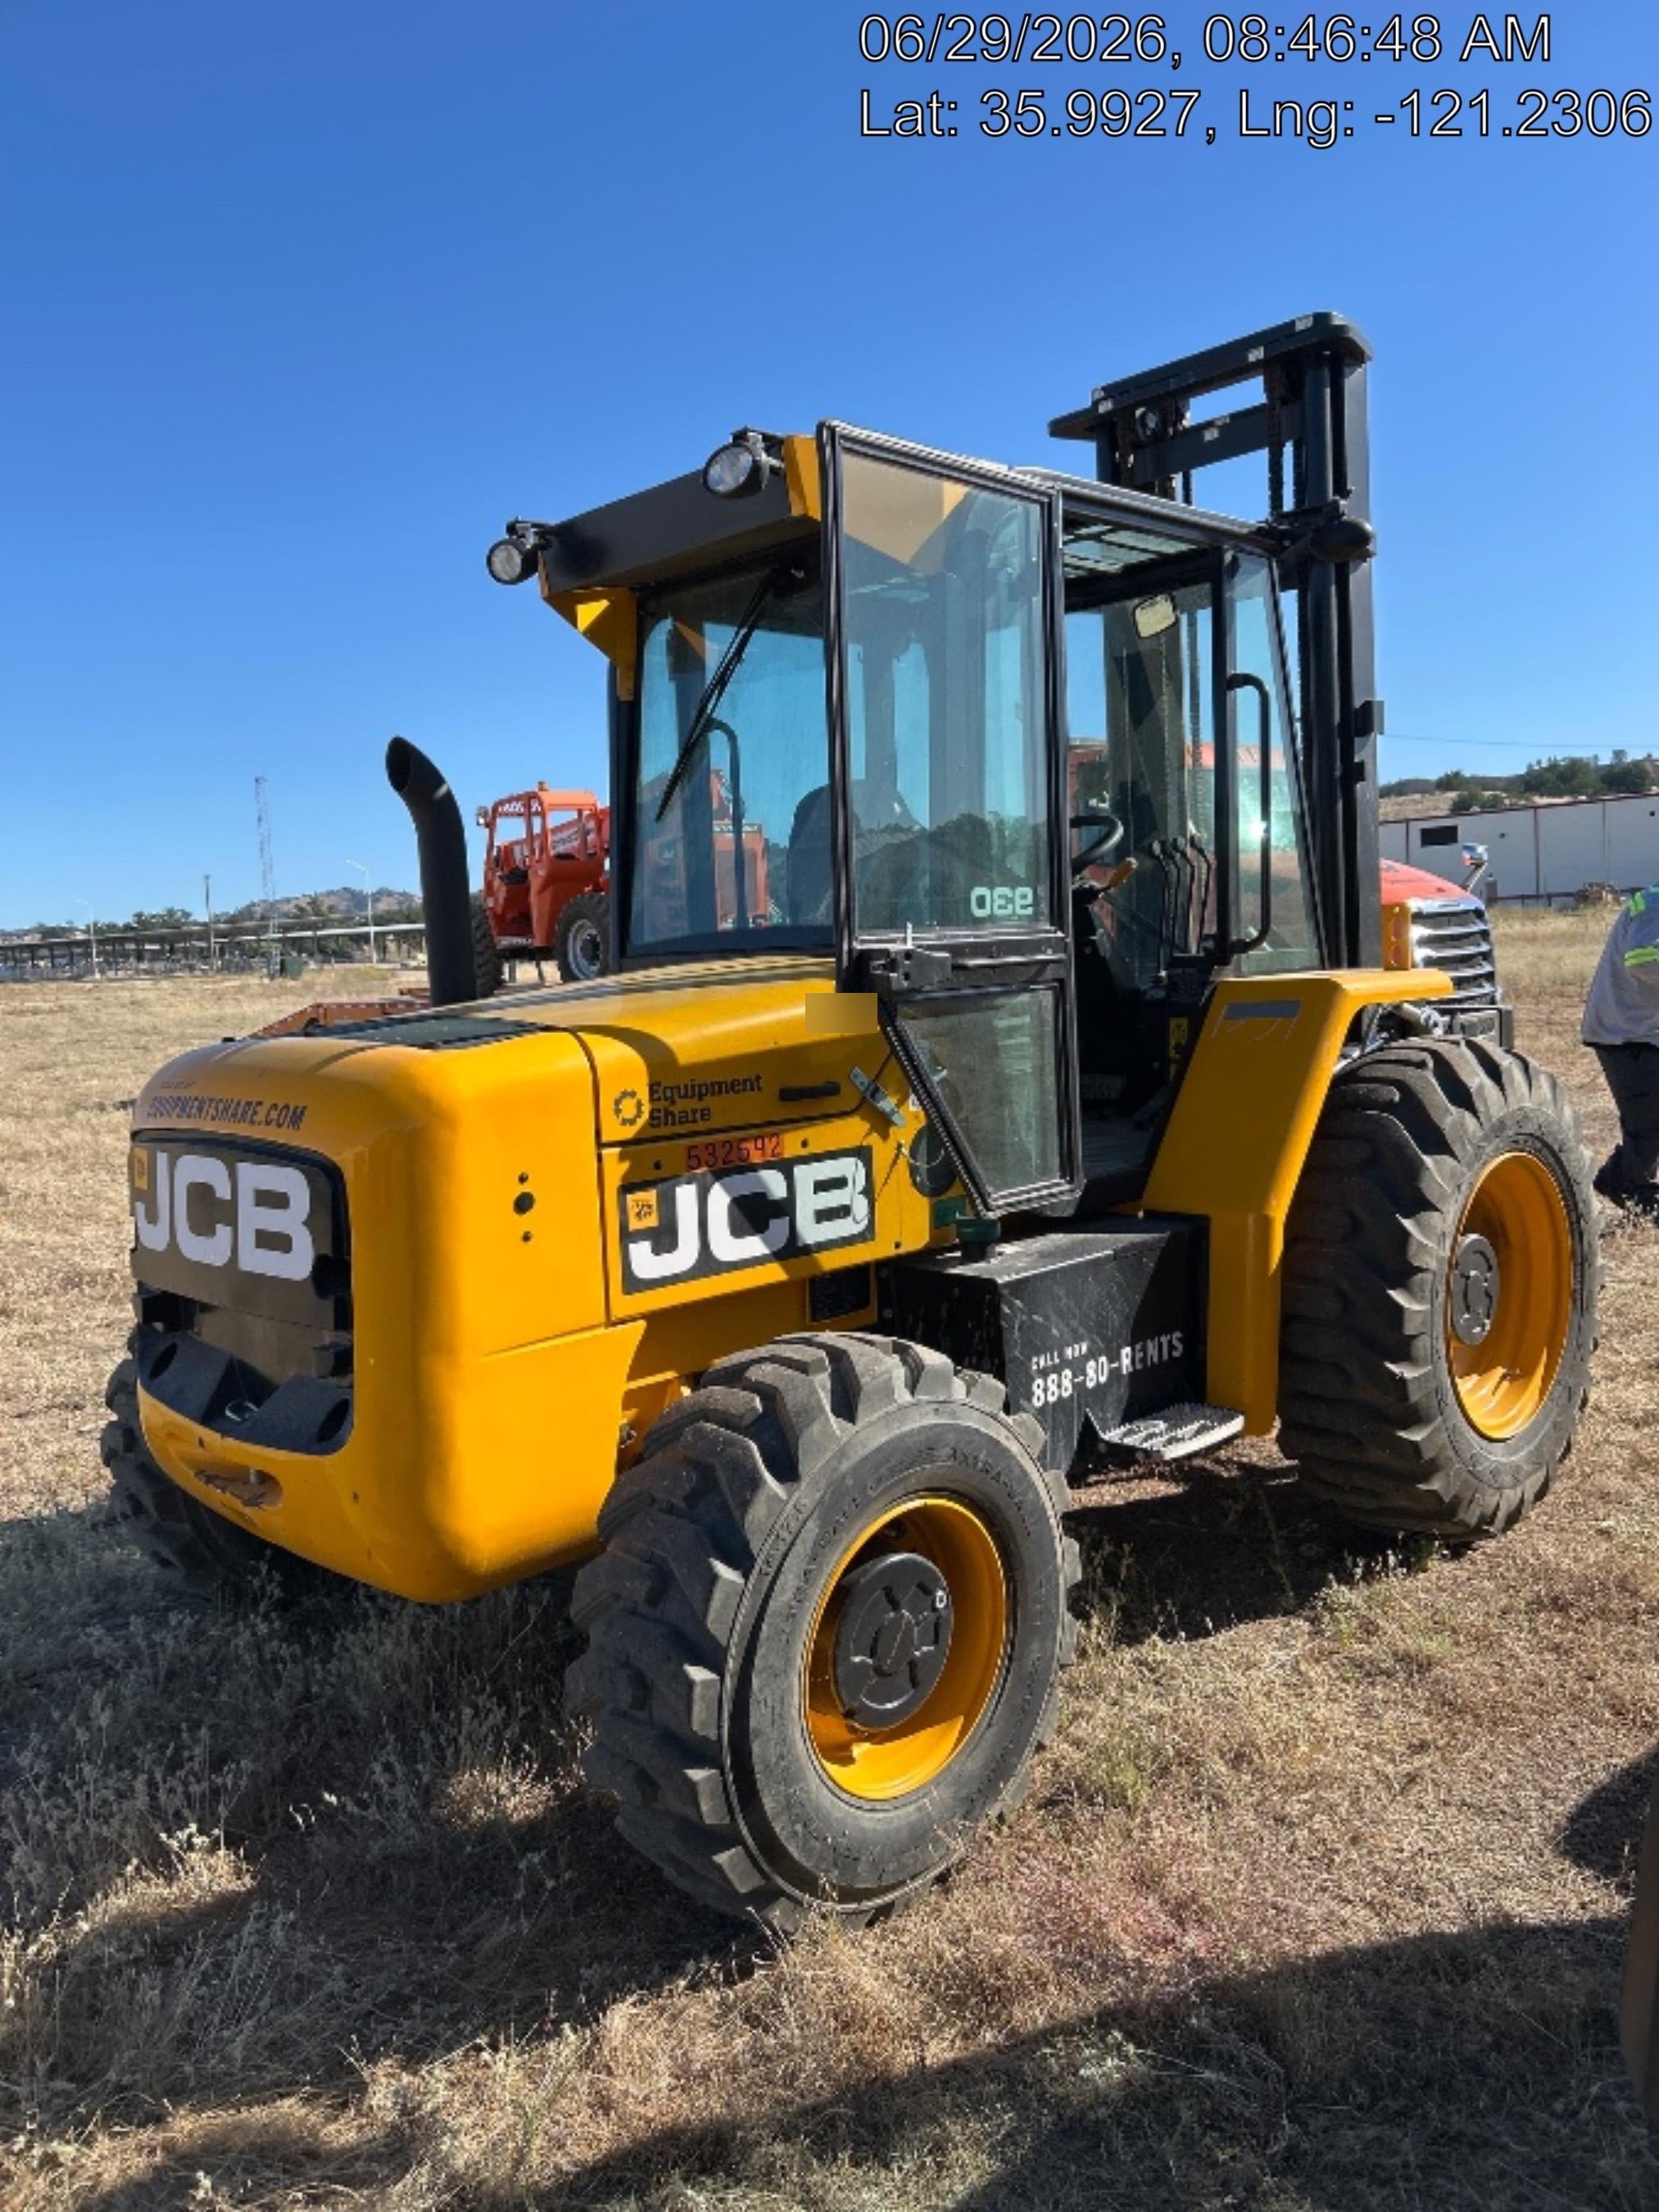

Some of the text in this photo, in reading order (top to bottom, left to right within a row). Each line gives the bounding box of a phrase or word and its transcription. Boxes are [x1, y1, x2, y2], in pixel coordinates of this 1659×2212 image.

[649, 1073, 764, 1104] Equipment
[649, 1108, 711, 1128] Share
[134, 1150, 314, 1281] JCB
[628, 1156, 870, 1280] JCB
